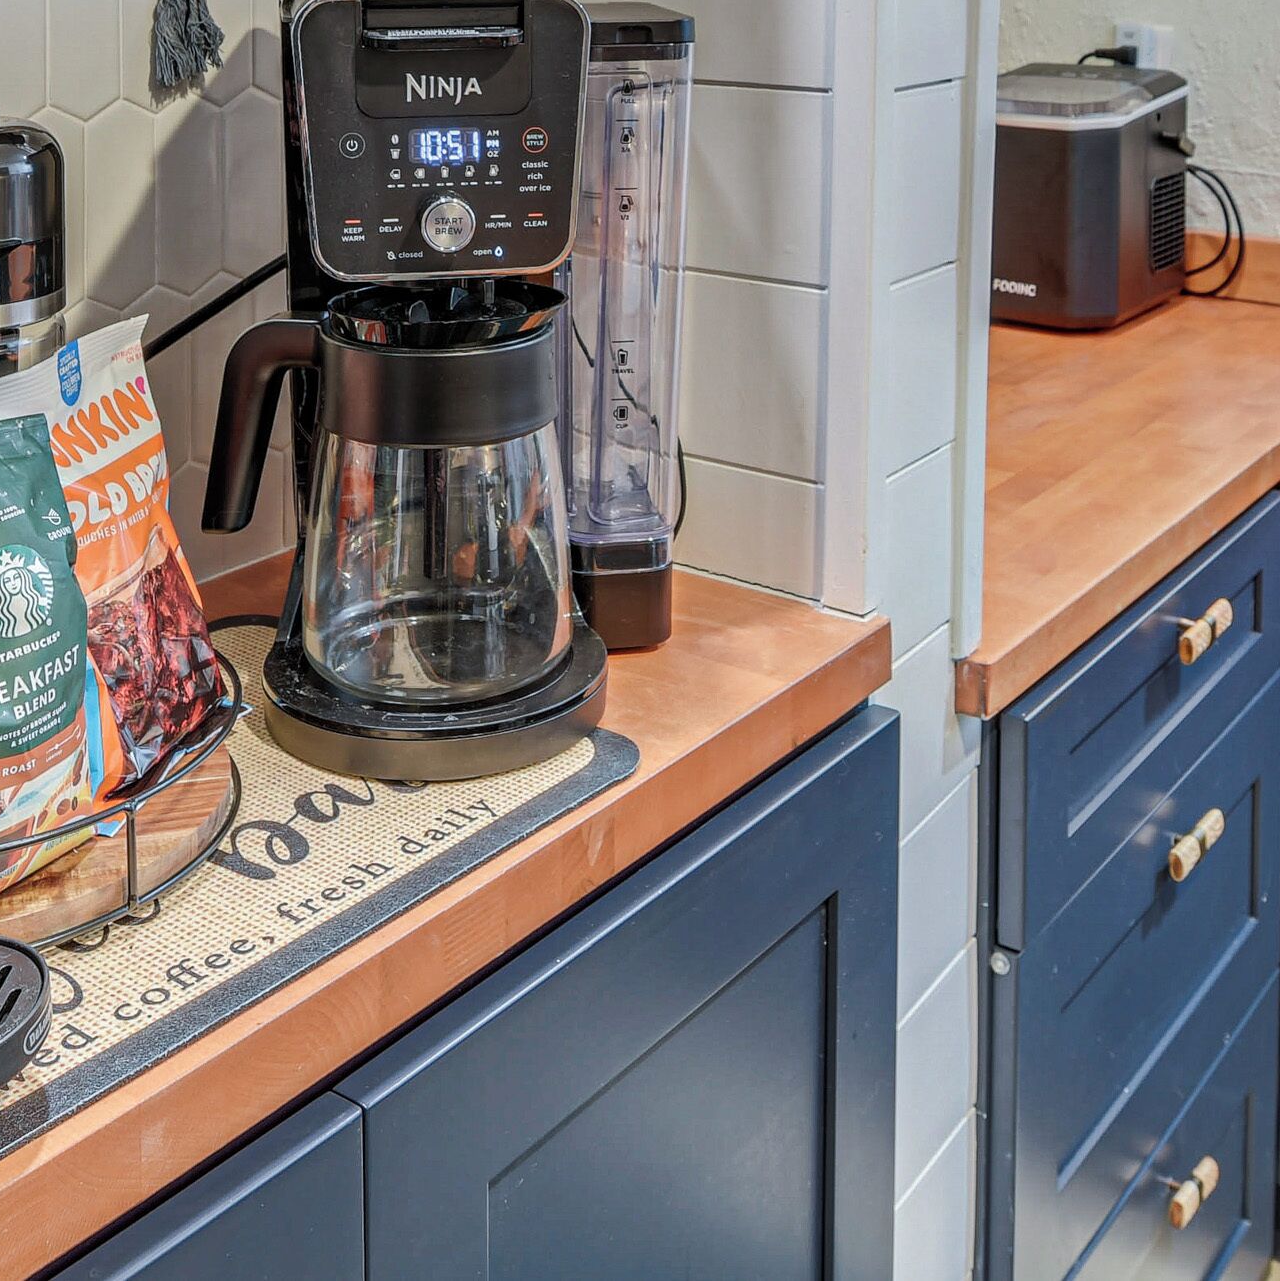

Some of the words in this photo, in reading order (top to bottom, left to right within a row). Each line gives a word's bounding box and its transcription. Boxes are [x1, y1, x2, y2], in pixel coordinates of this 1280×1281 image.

[405, 72, 482, 106] NINJA
[486, 129, 500, 137] AM
[420, 129, 479, 161] 10:51
[485, 139, 500, 148] PM
[486, 150, 499, 158] OZ
[521, 160, 549, 168] classic
[527, 172, 543, 181] rich
[519, 185, 537, 193] over
[539, 183, 552, 192] ice
[434, 218, 464, 226] START
[484, 221, 512, 230] HR/MIN
[378, 225, 403, 233] DELAY
[434, 227, 463, 236] BREW
[341, 235, 365, 243] WARM
[398, 251, 424, 259] closed
[472, 249, 493, 257] open
[1, 508, 26, 523] SOURCING
[13, 688, 56, 720] BLEND
[21, 724, 30, 734] OF
[29, 711, 52, 729] BROWN
[18, 729, 39, 746] SWEET
[2, 758, 37, 778] ROAST
[113, 934, 276, 1021] coffee,
[276, 860, 396, 925] fresh
[397, 799, 498, 855] daily
